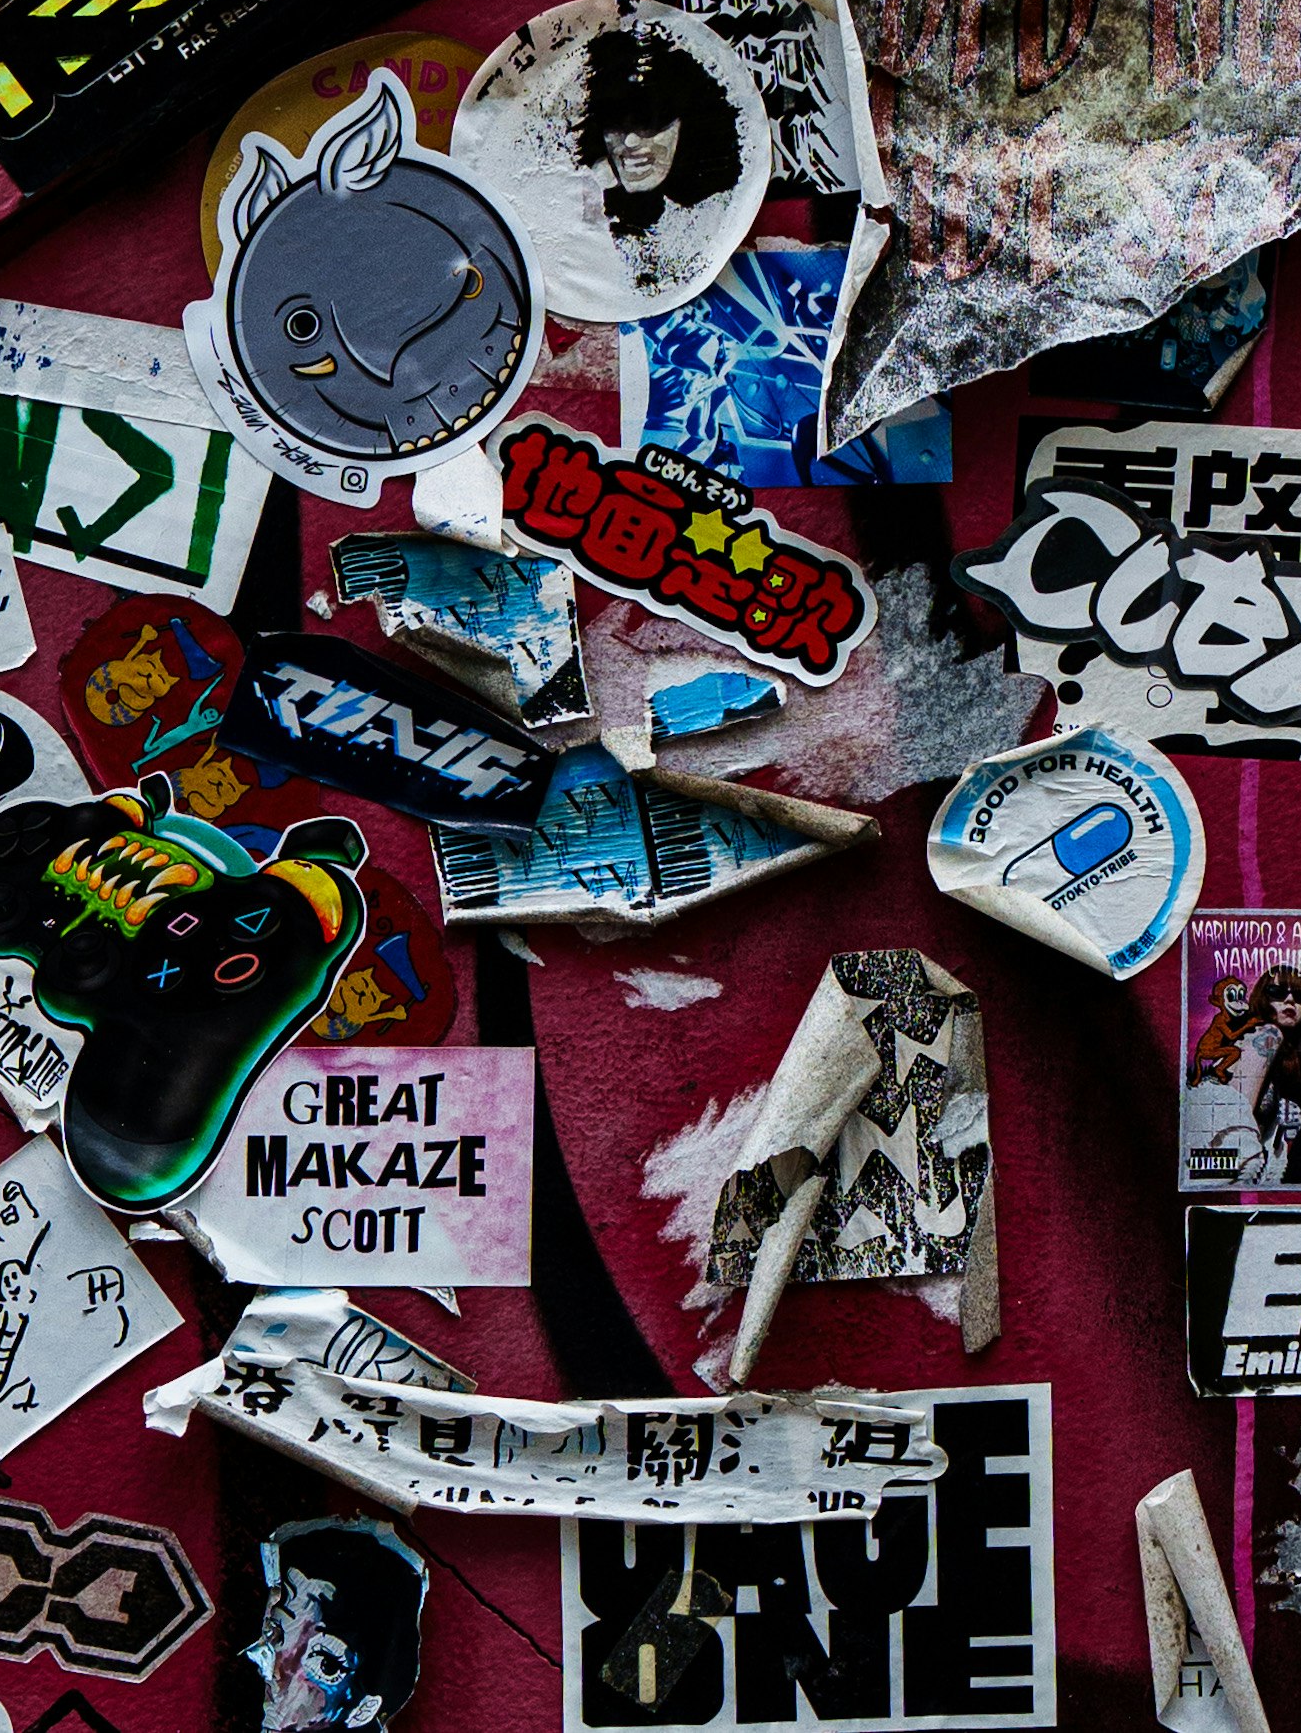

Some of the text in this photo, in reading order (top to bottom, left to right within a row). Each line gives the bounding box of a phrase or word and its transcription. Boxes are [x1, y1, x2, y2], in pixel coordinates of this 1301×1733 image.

[969, 755, 1165, 845] GOOD FOR HEALTH
[282, 1072, 445, 1126] GREAT
[245, 1134, 486, 1198] MAKAZE
[290, 1205, 426, 1256] SCOTT
